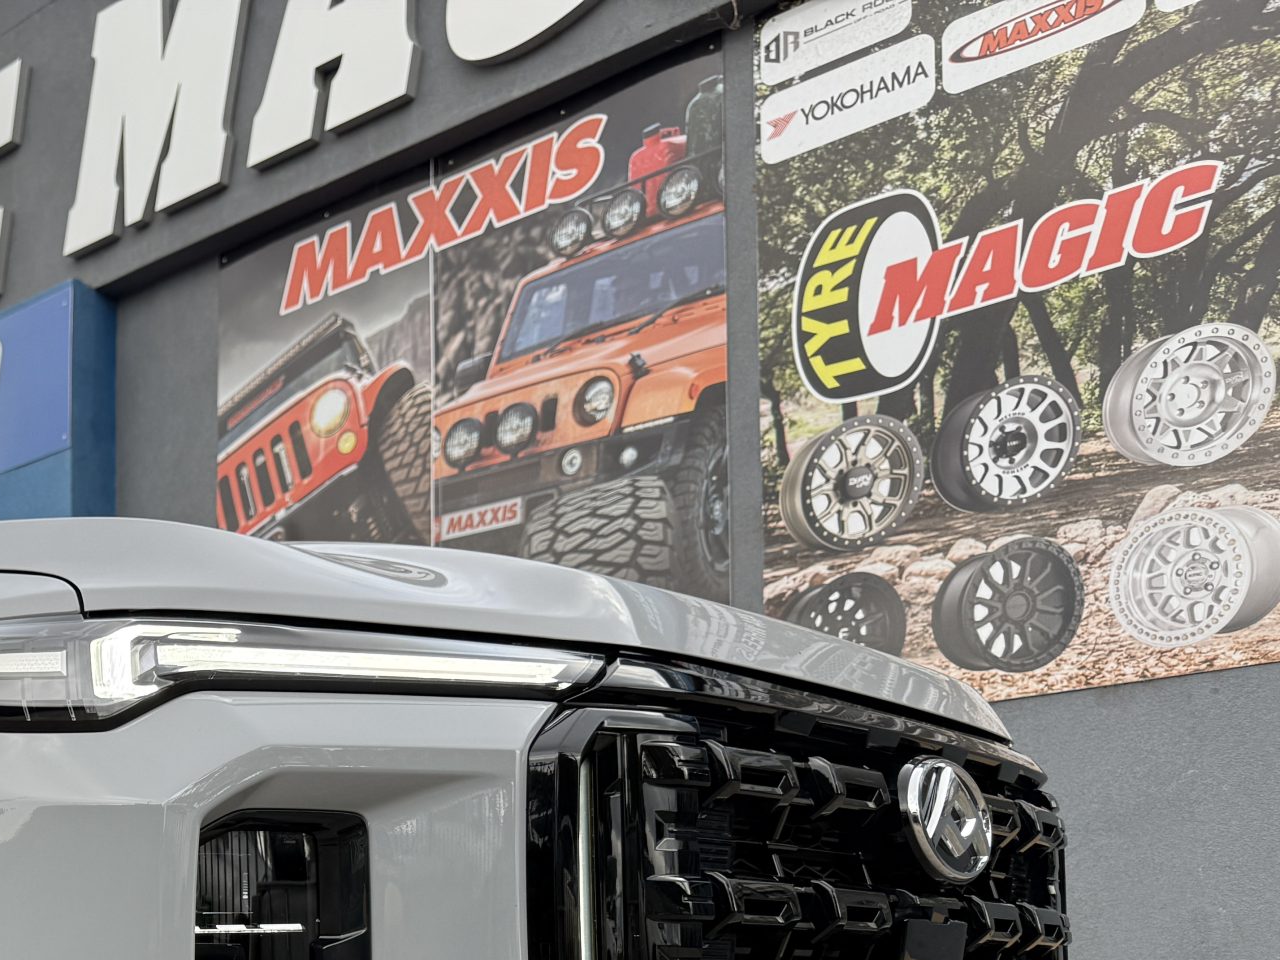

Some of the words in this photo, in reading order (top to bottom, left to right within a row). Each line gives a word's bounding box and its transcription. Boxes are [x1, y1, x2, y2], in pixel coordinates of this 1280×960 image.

[801, 61, 929, 125] YOKOHAMA
[803, 8, 856, 37] BLACK
[63, 0, 588, 257] MA
[282, 115, 607, 314] MAXXIS
[801, 216, 879, 390] TYRE
[867, 162, 1221, 338] MAGIC
[446, 502, 518, 534] MAXXIS
